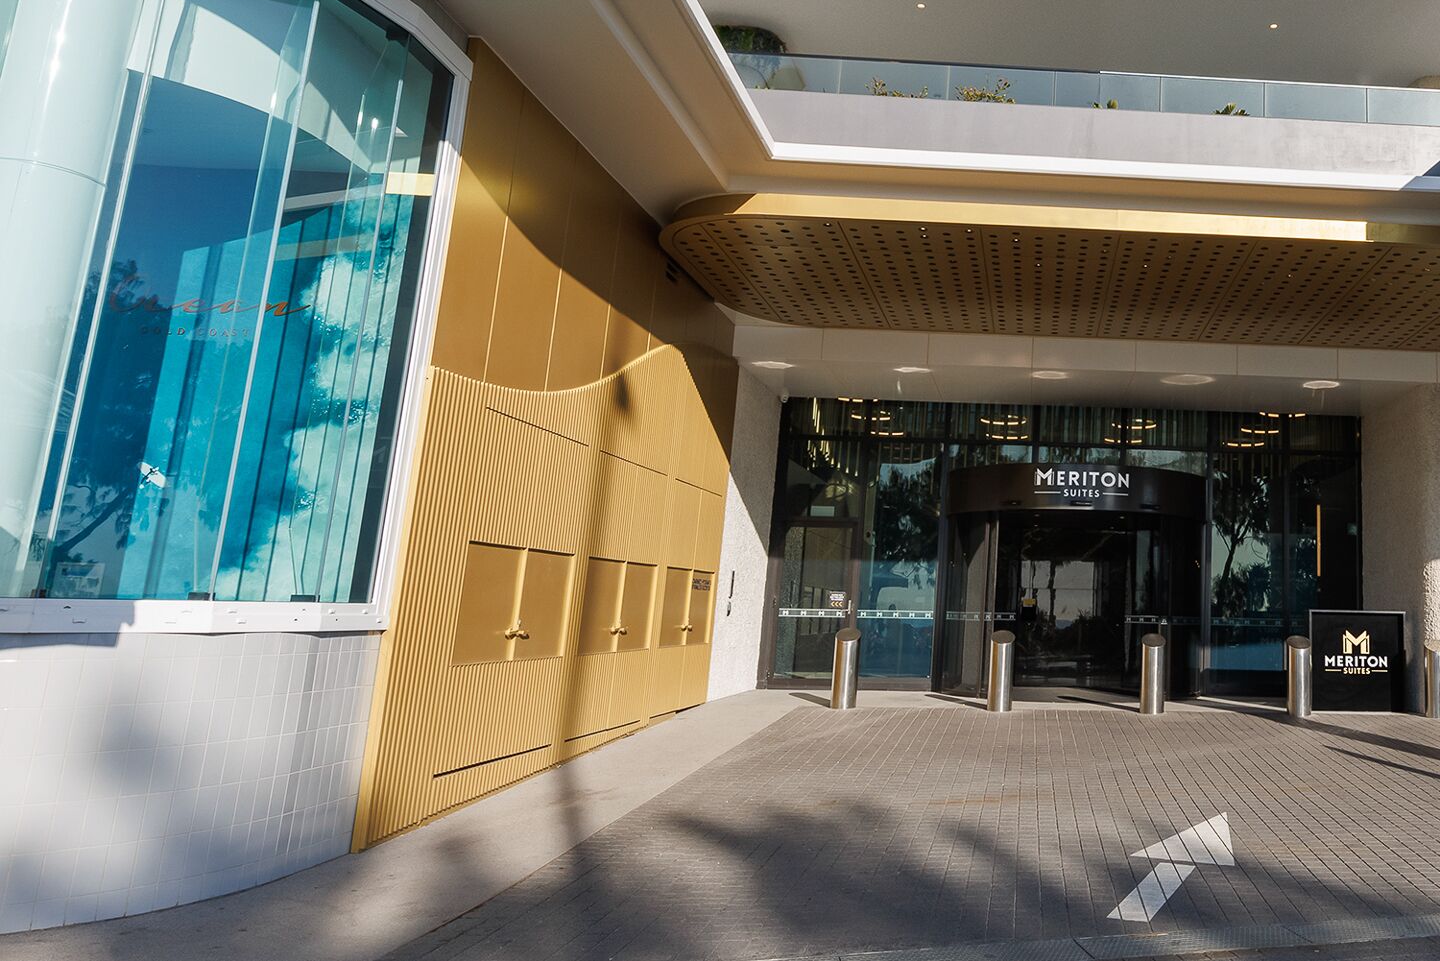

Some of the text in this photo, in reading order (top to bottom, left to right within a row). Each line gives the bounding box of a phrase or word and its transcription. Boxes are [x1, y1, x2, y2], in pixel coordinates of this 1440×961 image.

[1034, 467, 1130, 489] MERITON
[1063, 488, 1101, 498] SUITES
[1324, 654, 1389, 668] MERITON
[1343, 666, 1371, 675] SUITES
